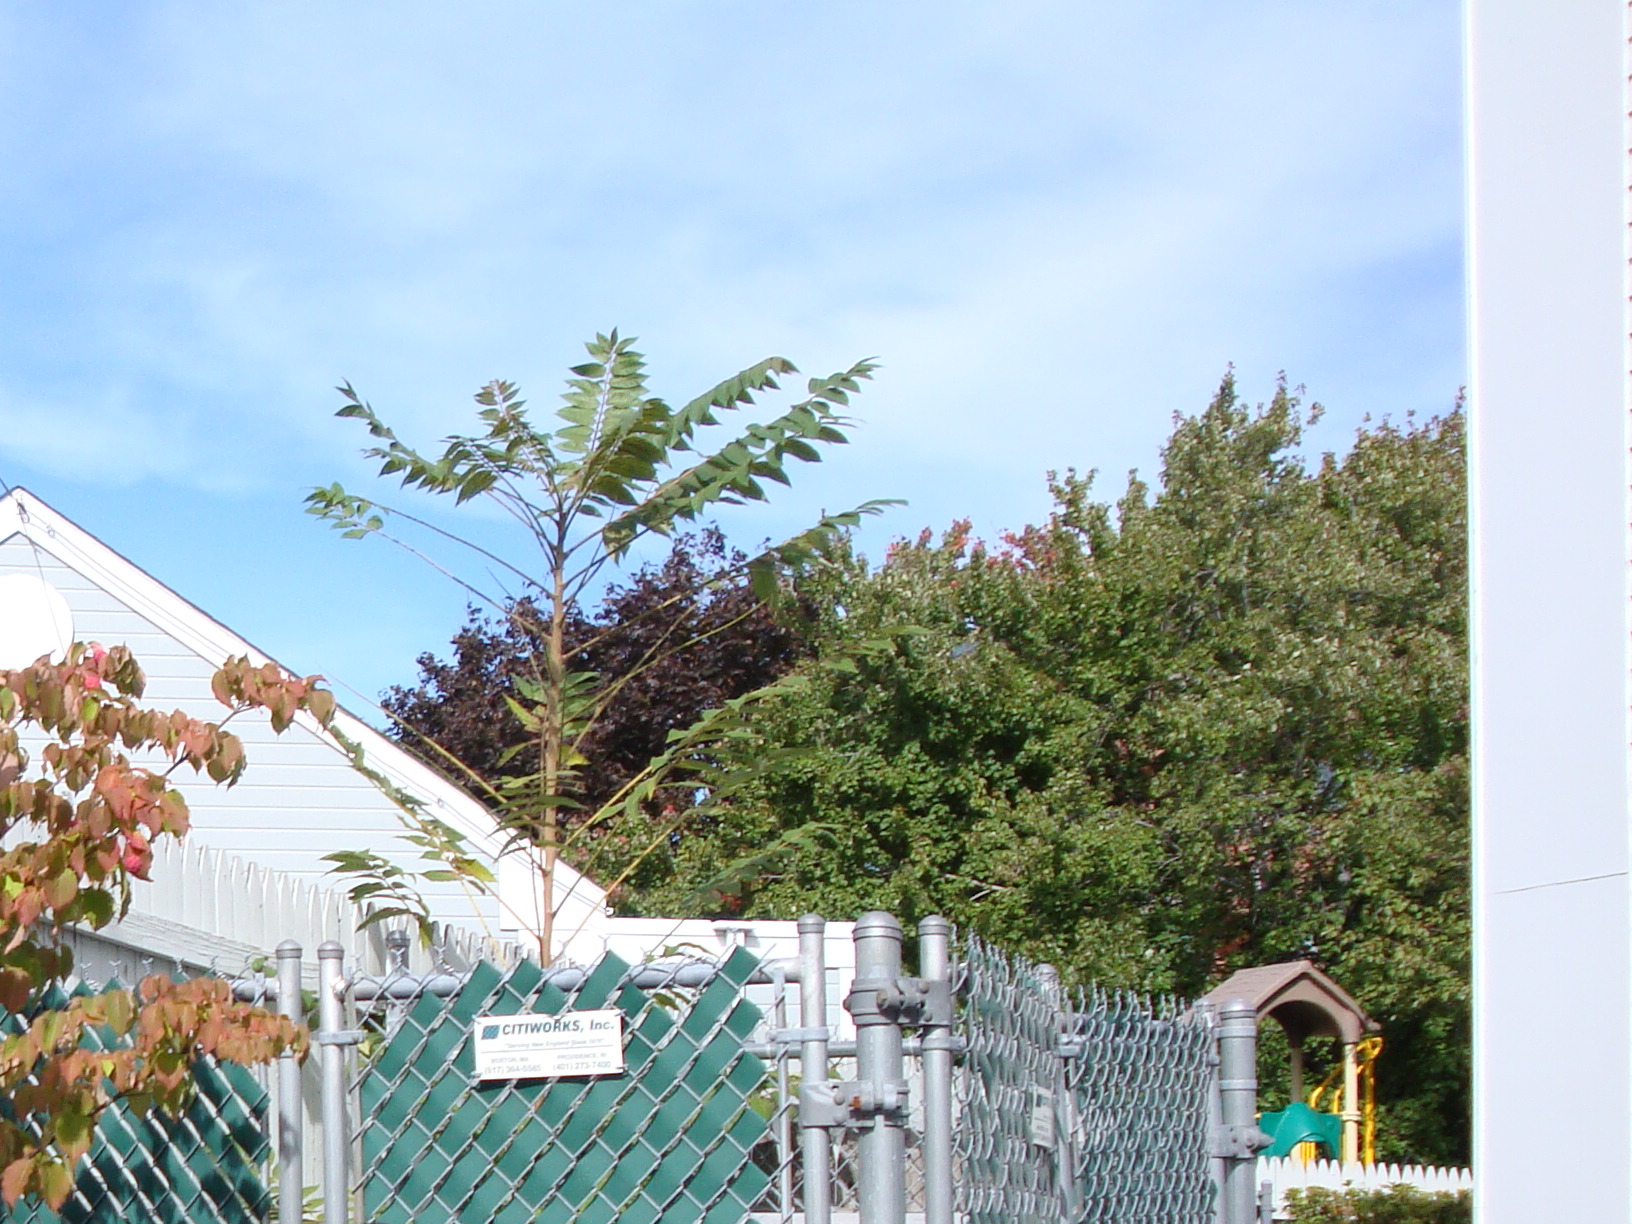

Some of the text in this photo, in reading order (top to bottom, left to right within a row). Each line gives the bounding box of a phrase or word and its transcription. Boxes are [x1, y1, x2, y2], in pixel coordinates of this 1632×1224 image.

[502, 1019, 615, 1036] CITIWORKS, Inc.
[552, 1063, 573, 1072] (401)
